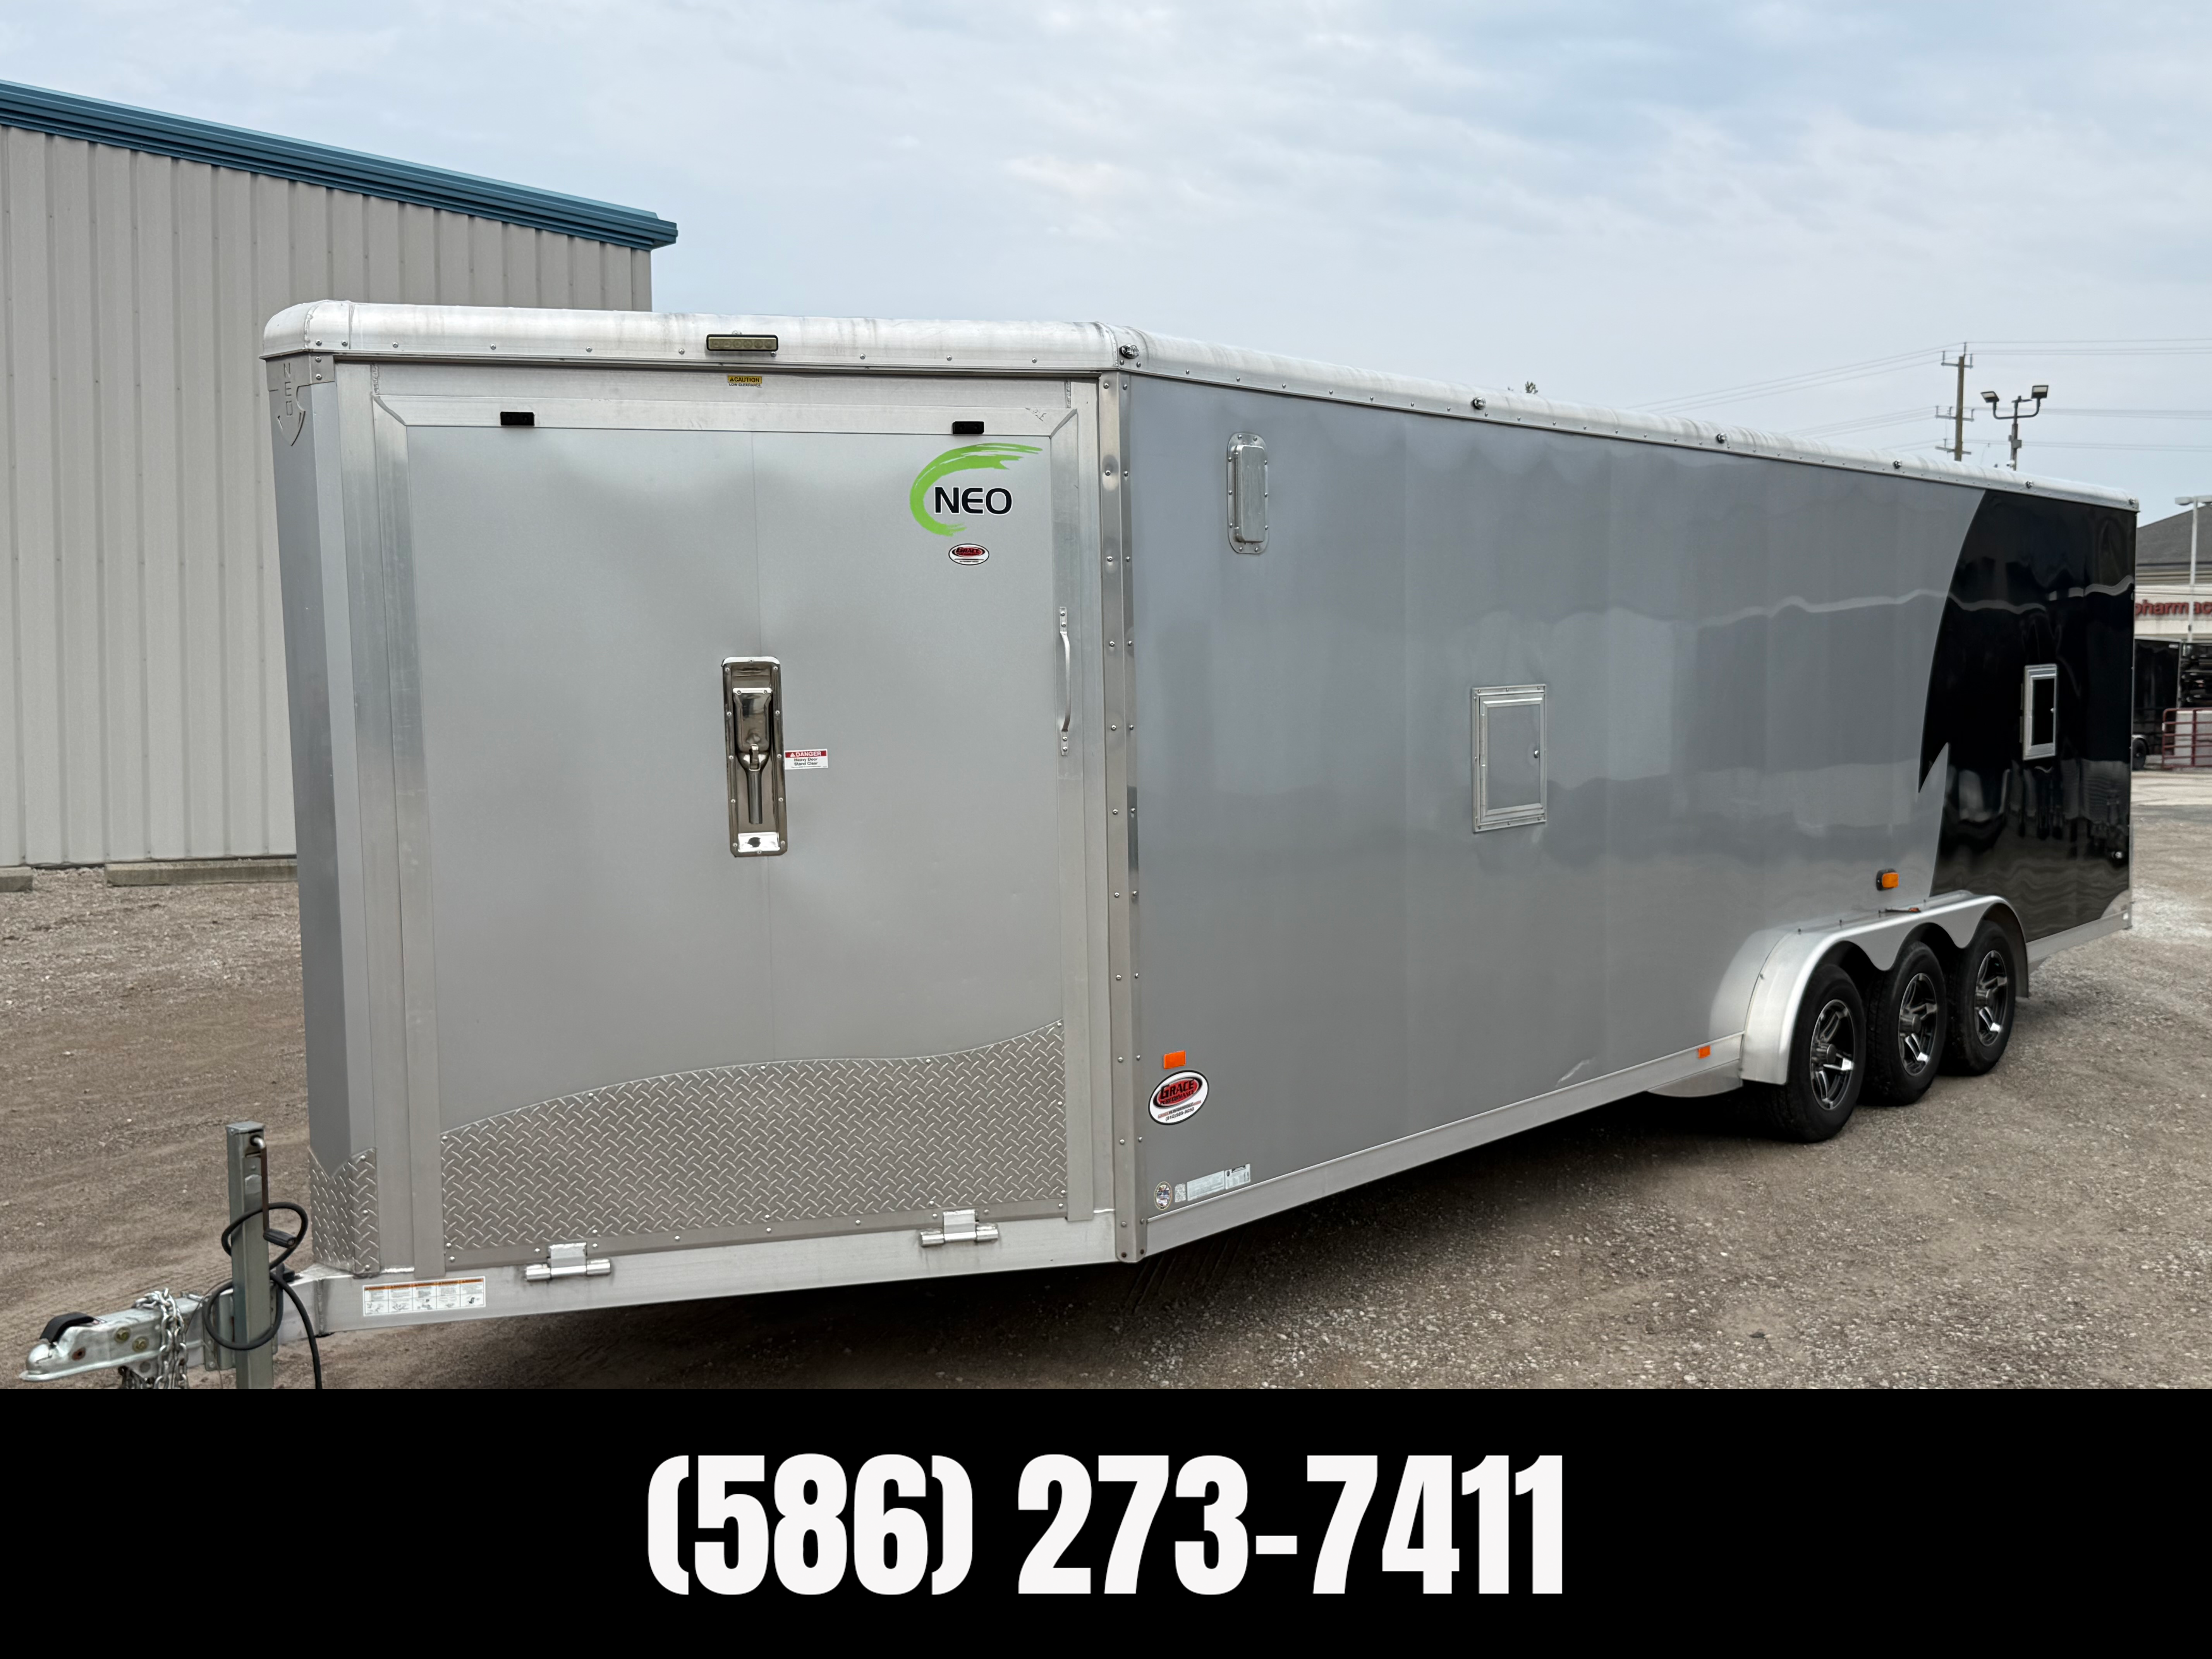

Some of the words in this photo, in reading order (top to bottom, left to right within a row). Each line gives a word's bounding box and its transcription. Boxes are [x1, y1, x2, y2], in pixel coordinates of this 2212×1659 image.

[283, 362, 293, 416] NEO
[934, 486, 1013, 515] NEO
[1160, 1079, 1194, 1099] GRACE
